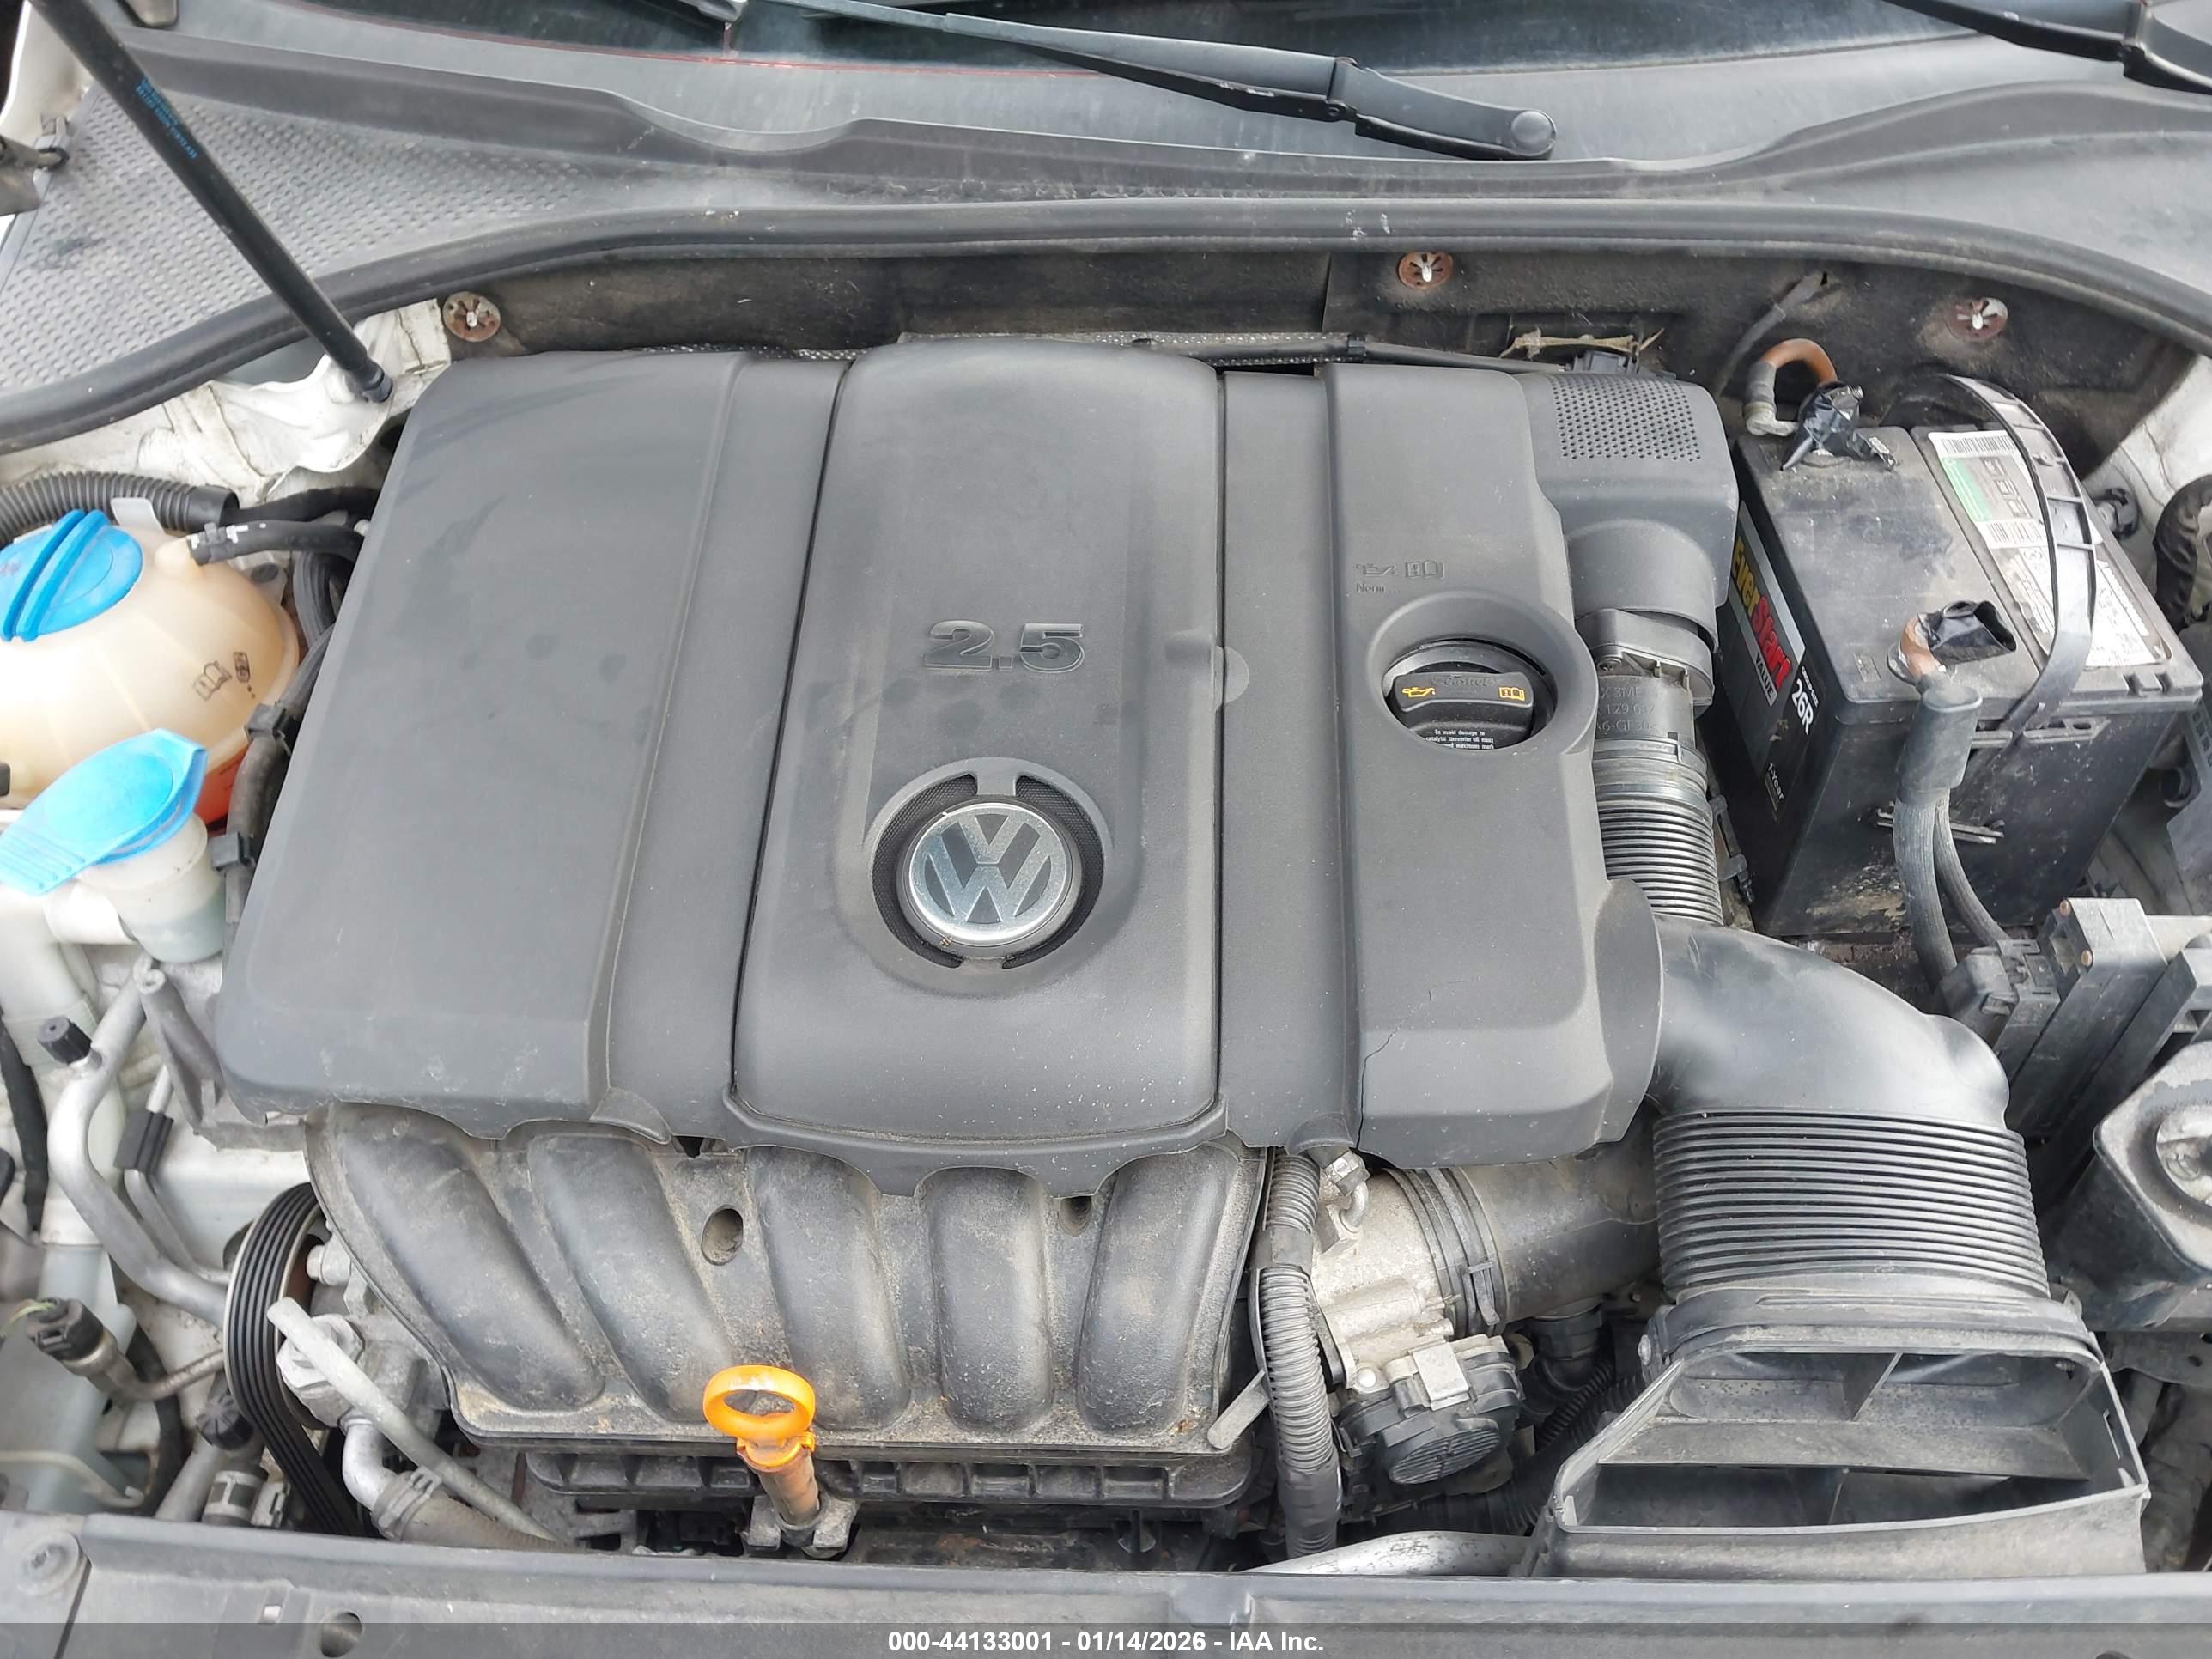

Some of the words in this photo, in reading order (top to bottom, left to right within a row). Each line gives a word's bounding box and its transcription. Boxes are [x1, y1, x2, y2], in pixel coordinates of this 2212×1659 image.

[924, 619, 1085, 673] 2.5
[1754, 652, 1774, 700] VALUE
[1791, 678, 1814, 736] 26R
[1767, 762, 1785, 800] 1-Year
